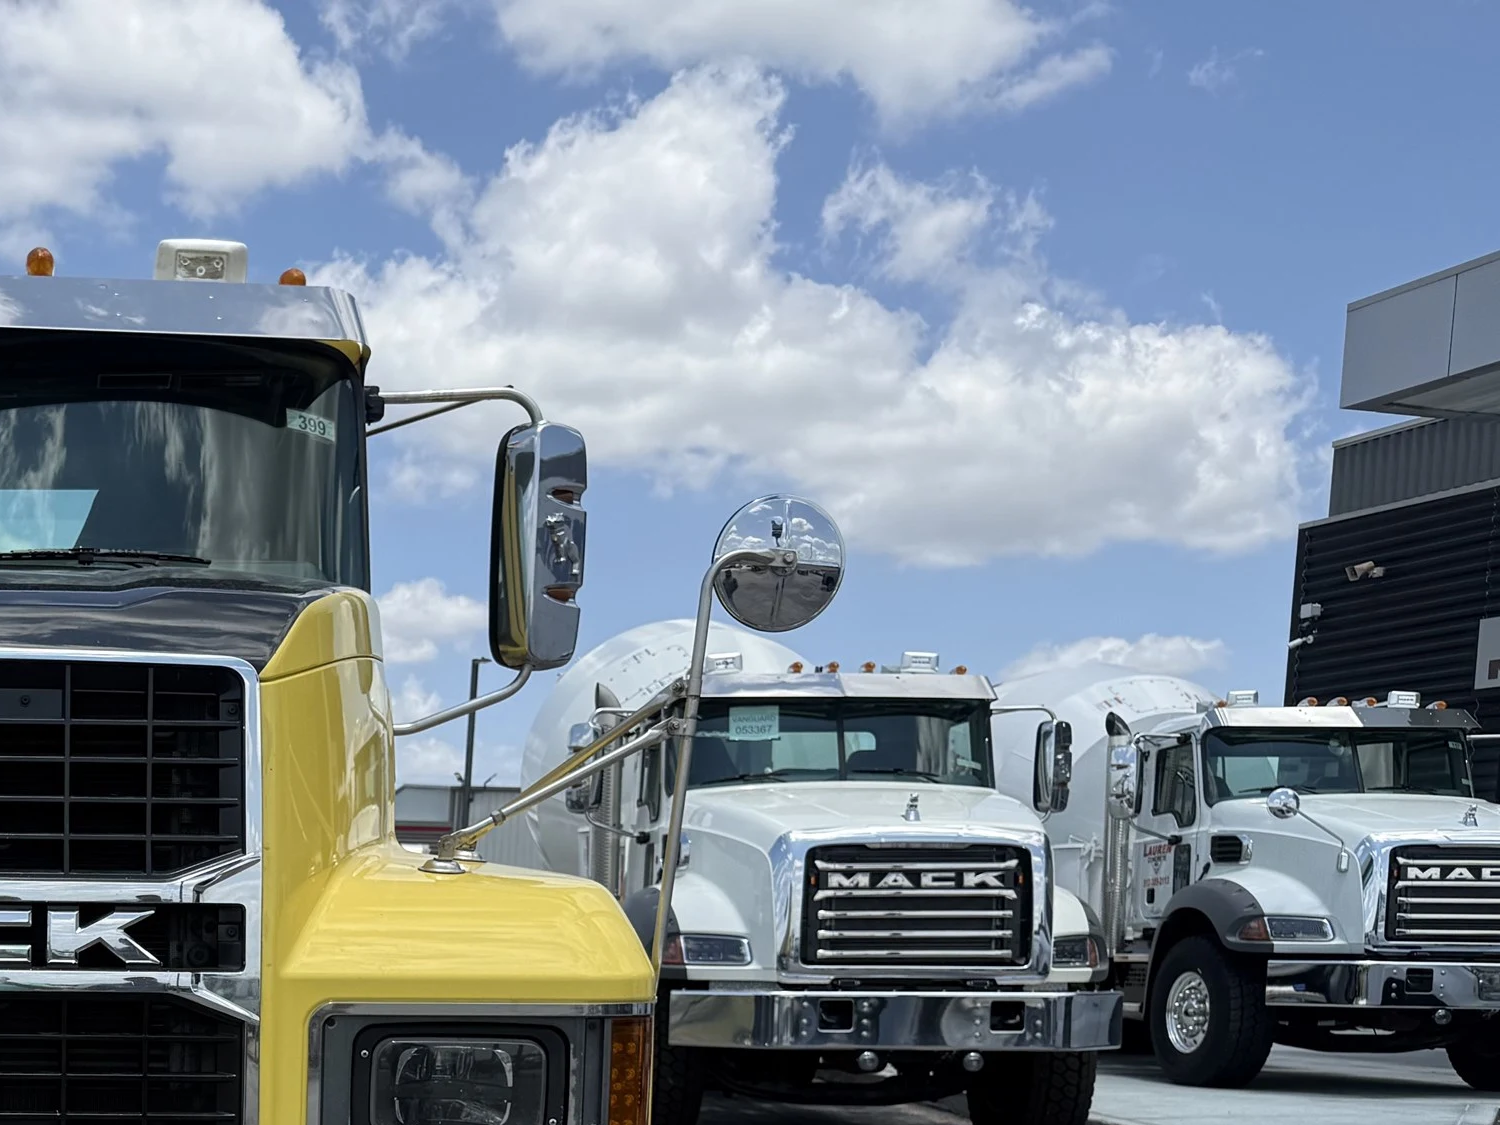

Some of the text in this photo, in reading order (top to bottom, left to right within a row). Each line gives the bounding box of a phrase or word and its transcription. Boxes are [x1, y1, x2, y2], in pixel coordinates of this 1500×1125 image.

[298, 414, 326, 436] 399
[732, 713, 777, 723] VANGUARD
[828, 871, 1005, 888] MACK
